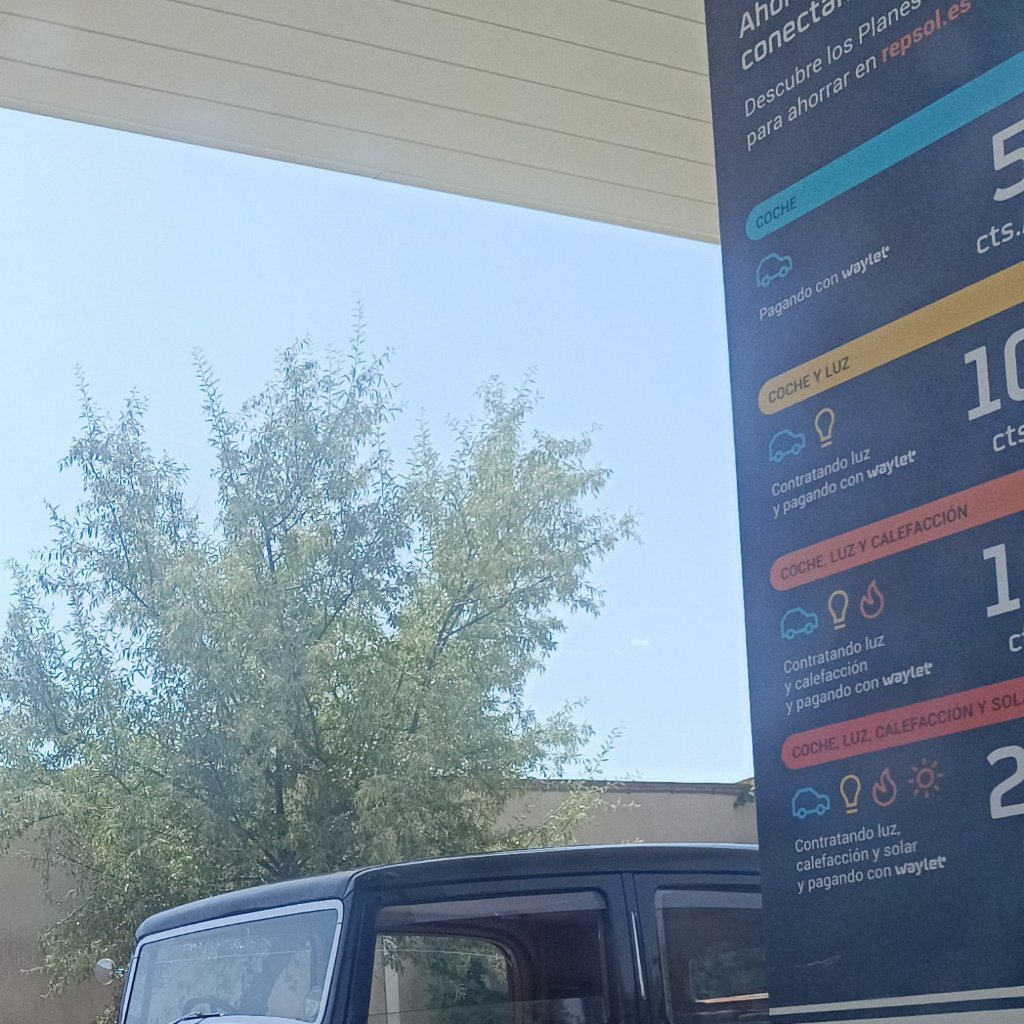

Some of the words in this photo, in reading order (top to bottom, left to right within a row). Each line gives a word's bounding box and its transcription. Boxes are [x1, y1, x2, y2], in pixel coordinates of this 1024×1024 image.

[744, 58, 823, 118] Descubre
[826, 37, 854, 65] los
[858, 0, 922, 45] Planes
[746, 115, 783, 151] para
[787, 72, 850, 122] ahorrar
[855, 55, 877, 79] en
[881, 0, 972, 63] repsol.es
[755, 196, 797, 229] COCHE
[759, 286, 813, 321] Pagando
[814, 272, 840, 294] con
[767, 377, 811, 405] COCHE
[813, 368, 822, 383] Y
[824, 356, 851, 378] LUZ
[771, 457, 849, 497] Contratando
[850, 447, 871, 465] luz
[772, 503, 780, 520] y
[782, 482, 837, 516] pagando
[839, 472, 865, 490] con
[830, 543, 856, 563] LUZ
[858, 540, 868, 552] Y
[870, 503, 969, 550] CALEFACCIÓN
[783, 642, 862, 674] Contratando
[865, 634, 886, 651] luz
[784, 680, 793, 696] y
[794, 659, 869, 691] calefacción
[786, 700, 794, 716] y
[795, 683, 853, 714] pagando
[855, 676, 880, 692] con
[791, 737, 840, 760] COCHE,
[842, 729, 873, 749] LUZ,
[875, 702, 974, 741] CALEFACCIÓN
[977, 700, 988, 715] Y
[991, 692, 1024, 711] SOL
[794, 825, 875, 853] Contratando
[876, 821, 902, 839] luz,
[795, 847, 870, 873] calefacción
[871, 848, 880, 863] y
[883, 840, 919, 858] solar
[797, 879, 805, 894] y
[807, 868, 864, 893] pagando
[866, 863, 893, 880] con
